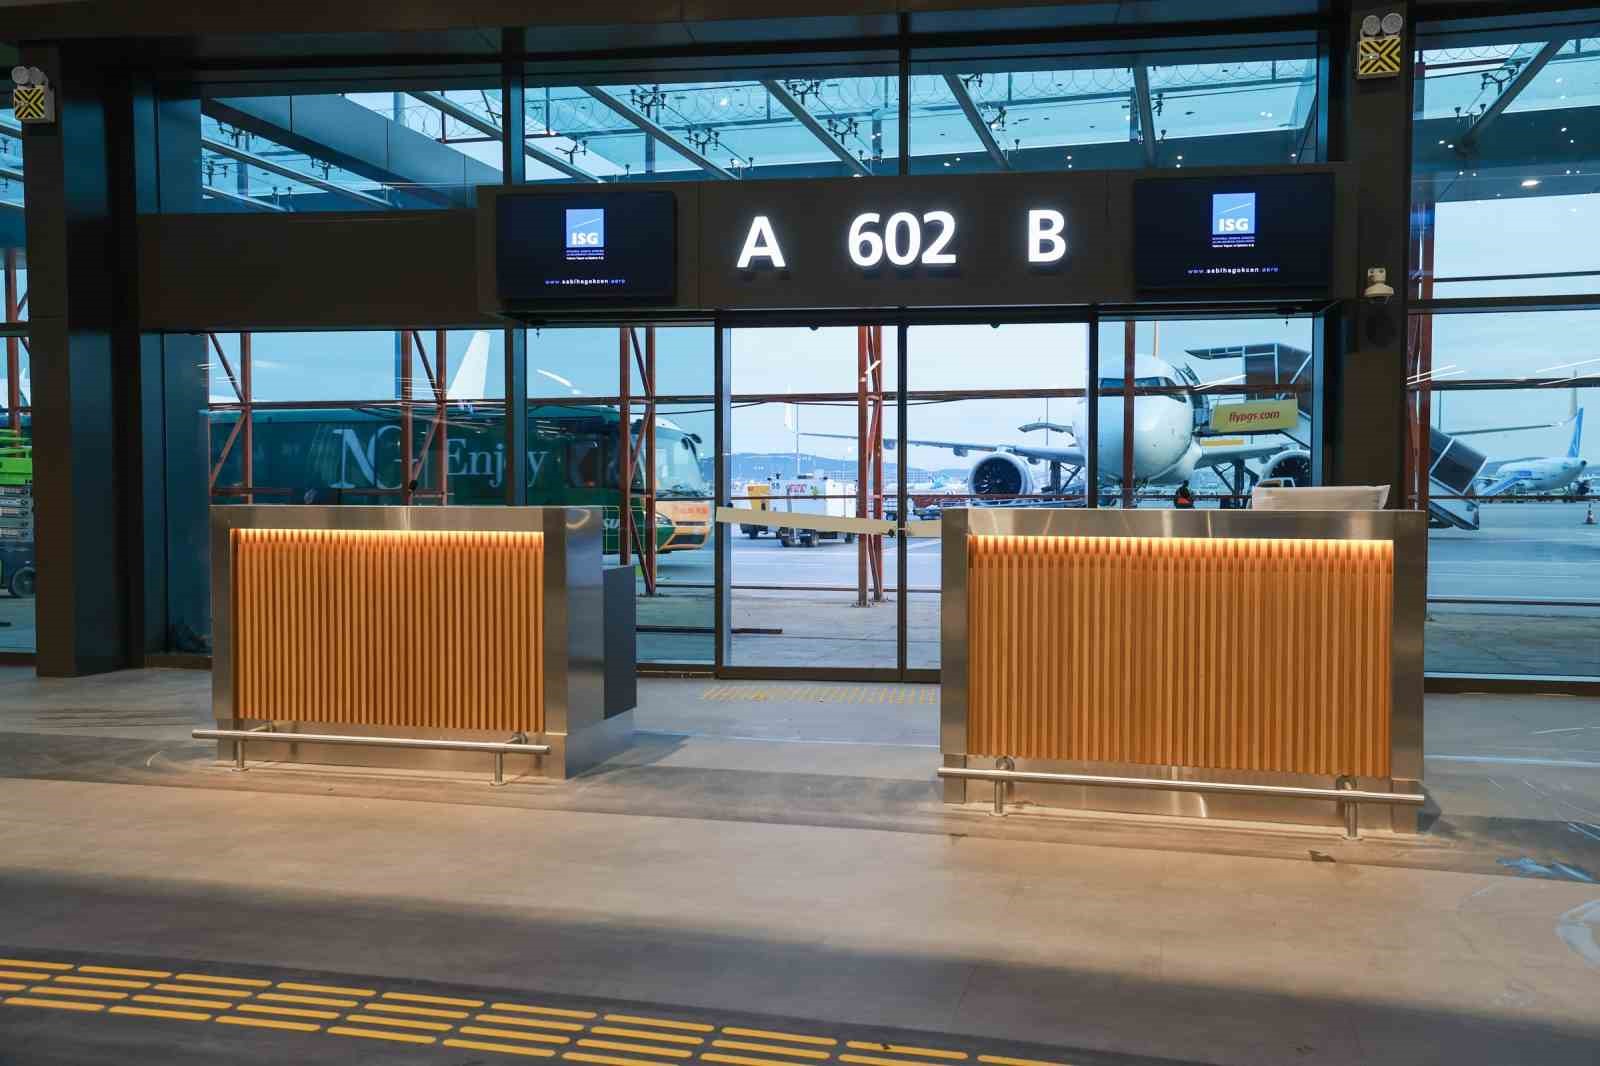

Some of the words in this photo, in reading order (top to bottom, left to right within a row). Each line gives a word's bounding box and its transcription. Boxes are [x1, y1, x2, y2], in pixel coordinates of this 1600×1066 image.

[736, 215, 786, 268] A
[848, 211, 957, 266] 602
[1028, 209, 1066, 263] B
[1218, 217, 1249, 232] ISG
[1229, 411, 1280, 424] flypgs.com
[446, 438, 552, 488] Enjy
